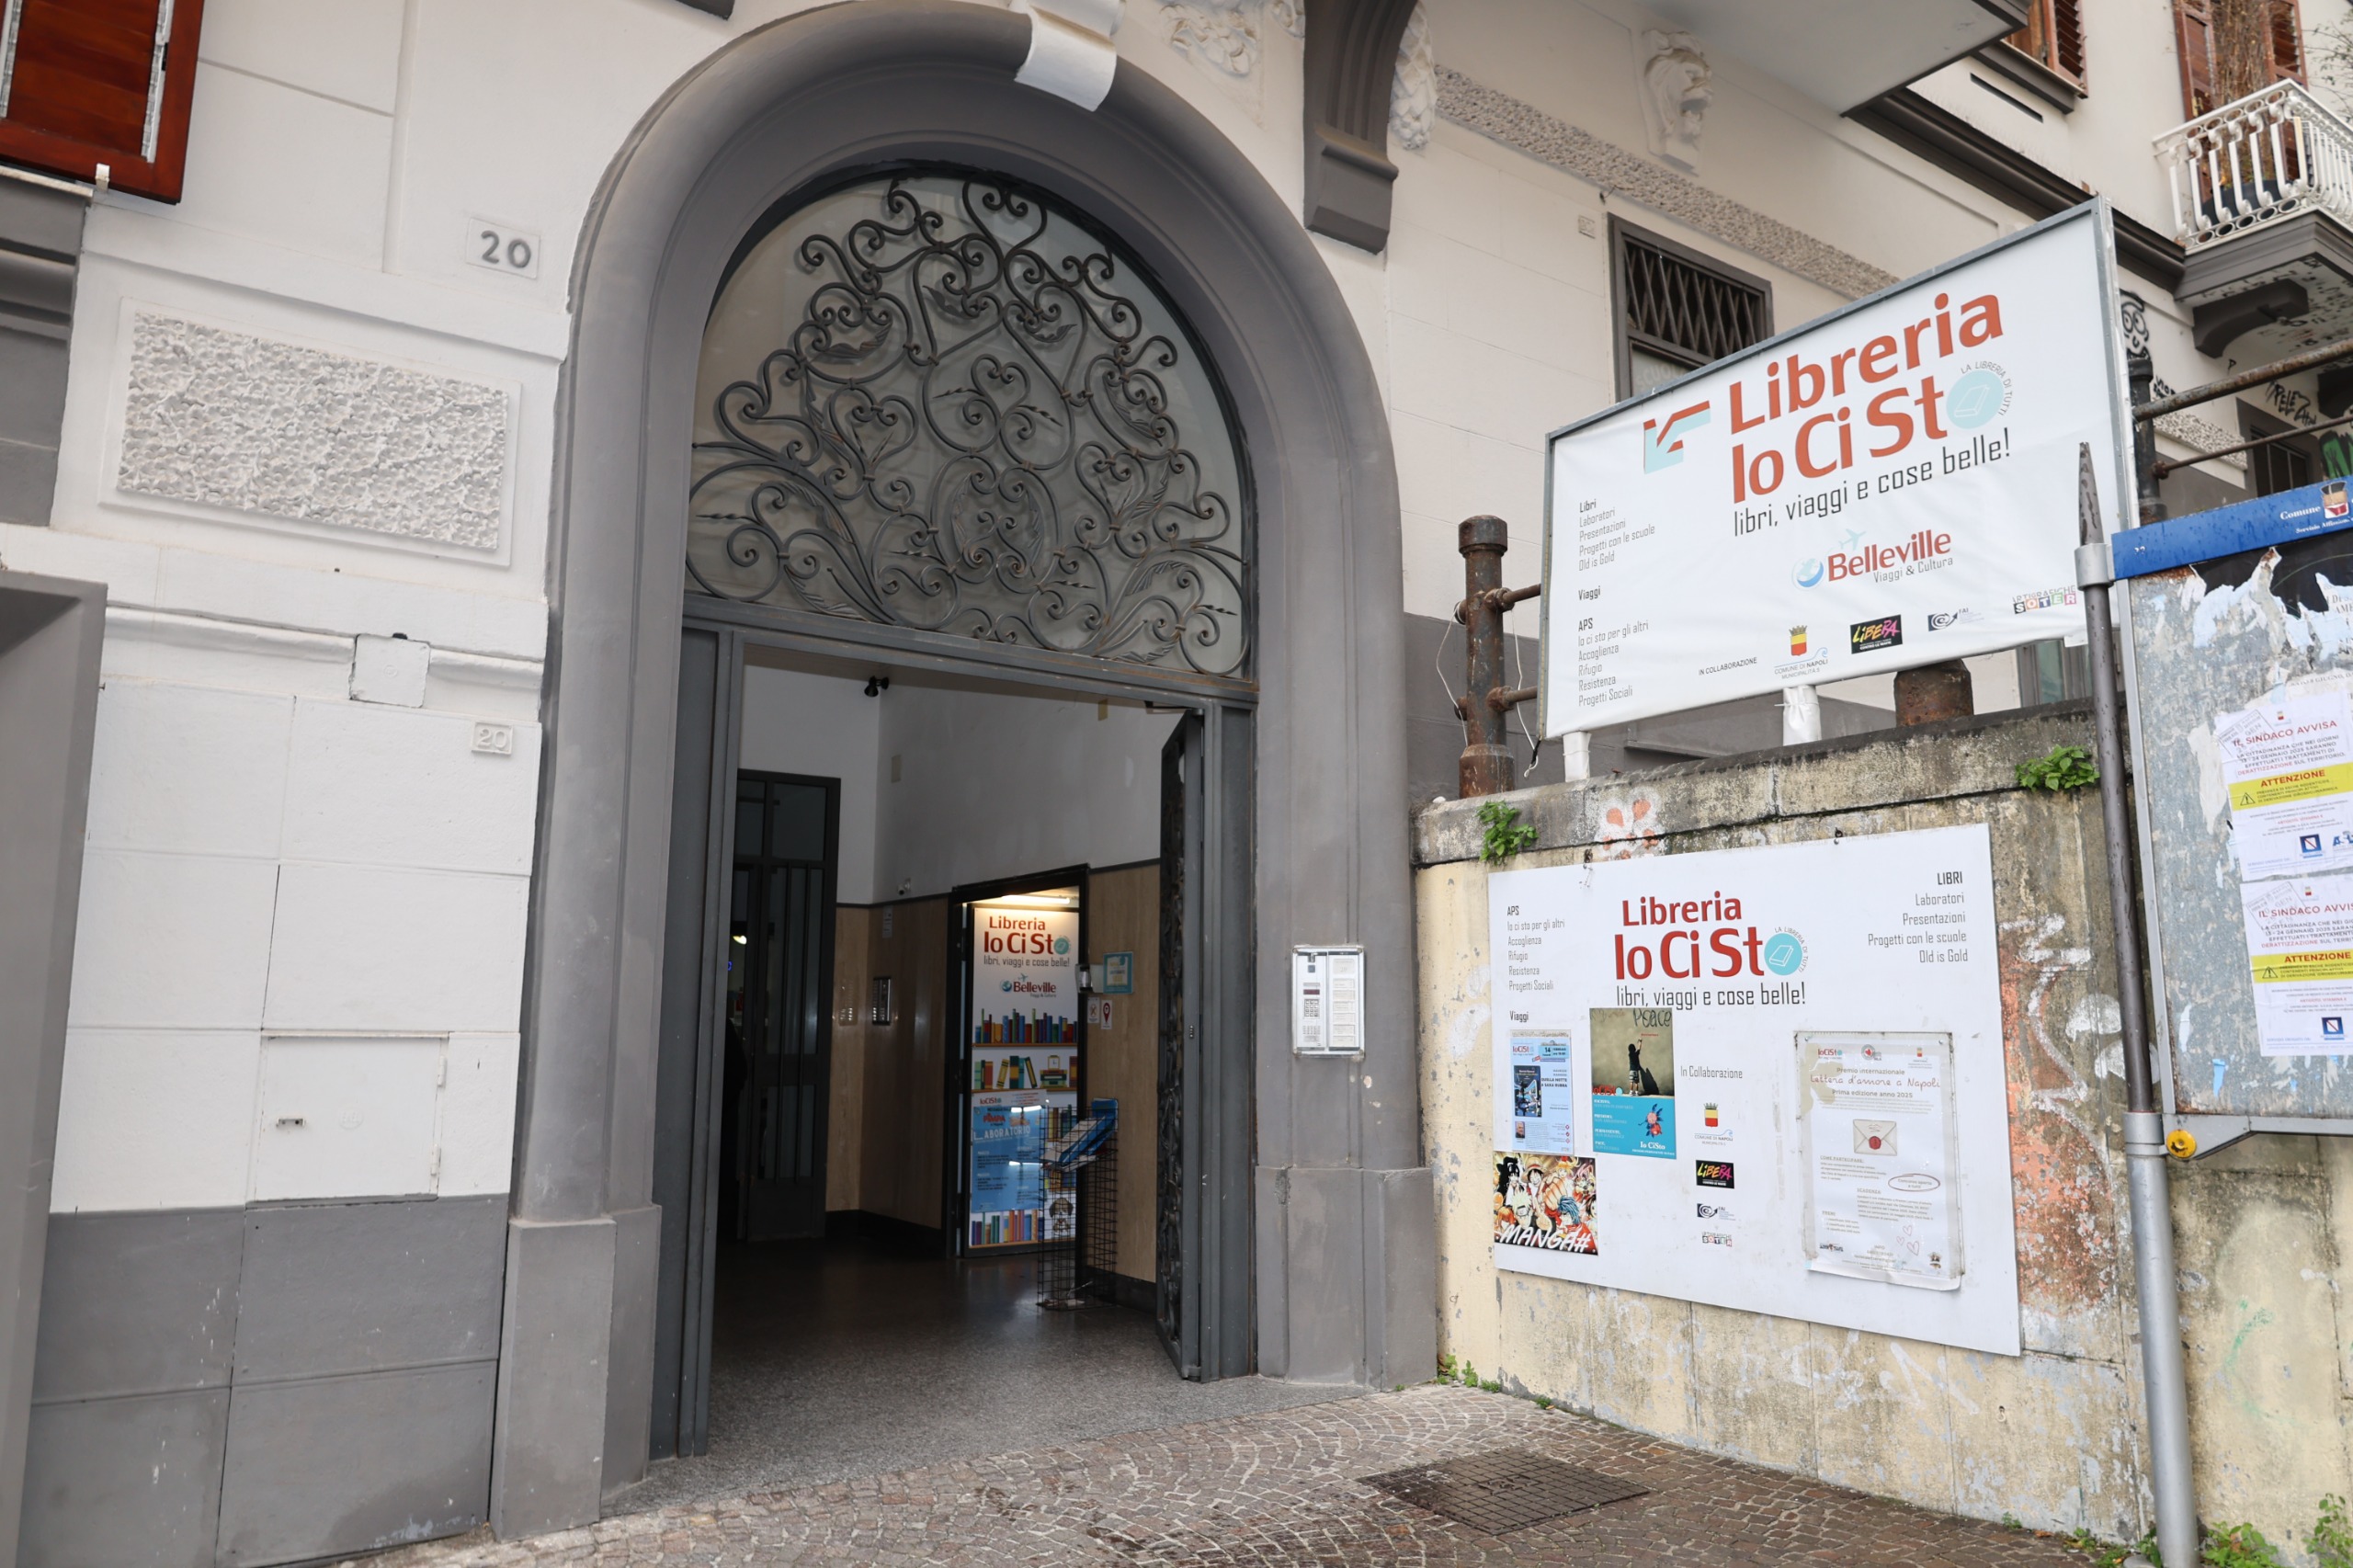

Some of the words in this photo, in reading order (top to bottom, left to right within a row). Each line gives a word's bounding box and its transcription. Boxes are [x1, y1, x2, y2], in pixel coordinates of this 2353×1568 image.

[481, 230, 531, 268] 20
[1730, 292, 2004, 435] Libreria
[1961, 364, 1972, 374] LA
[1975, 360, 2006, 379] LIBRERIA
[2003, 378, 2012, 389] DI
[1997, 391, 2013, 416] TUTTI
[1795, 406, 1853, 479] Ci
[1734, 504, 1779, 537] libri,
[1786, 481, 1847, 520] viaggi
[1858, 481, 1869, 500] e
[1879, 461, 1932, 494] cose
[1942, 427, 2010, 474] belle!
[1579, 498, 1597, 513] Libri
[2279, 506, 2322, 520] Comune
[1579, 506, 1615, 528] Laboratori
[1579, 517, 1626, 542] Presentazioni
[1579, 540, 1607, 557] Progetti
[1608, 536, 1621, 548] con
[1622, 531, 1630, 543] le
[1631, 524, 1655, 540] scuole
[1578, 558, 1590, 571] Old
[1591, 557, 1597, 568] is
[1599, 550, 1615, 565] Gold
[1828, 529, 1951, 582] Belleville
[1873, 567, 1904, 583] Viaggi
[1905, 565, 1915, 575] &
[1918, 556, 1953, 574] Cultura
[1578, 585, 1600, 600] Viaggi
[2014, 593, 2076, 614] SOTER
[1578, 618, 1593, 632] APS
[1586, 634, 1593, 645] ci
[1595, 632, 1606, 643] sto
[1608, 629, 1620, 642] per
[1622, 623, 1631, 639] gli
[1632, 619, 1649, 633] altri
[1578, 644, 1620, 662] Accoglienza
[1578, 663, 1602, 677] Rifugio
[1705, 656, 1757, 675] COLLABORAZIONE
[1774, 665, 1798, 675] COMUNE
[1806, 659, 1828, 668] NAPOLI
[1578, 676, 1617, 692] Resistenza
[1578, 691, 1608, 707] Progetti
[1608, 685, 1633, 701] Sociali
[478, 729, 507, 750] 20
[2245, 729, 2293, 745] SINDACO
[2297, 720, 2337, 734] AVVISA
[2245, 743, 2290, 757] CITTADINANZA
[2245, 756, 2280, 768] EFFETTUATI
[2285, 748, 2326, 761] TRATTAMENTI
[2261, 749, 2288, 761] GENNAIO
[2305, 742, 2336, 752] SARANNO
[2237, 761, 2293, 776] DERATTIZZAZIONE
[2260, 769, 2325, 788] ATTENZIONE
[1938, 871, 1963, 885] LIBRI
[1915, 892, 1964, 906] Laboratori
[1507, 905, 1519, 916] APS
[1622, 891, 1742, 926] Libreria
[2271, 906, 2320, 917] SINDACO
[989, 916, 1046, 931] Libreria
[1514, 920, 1519, 931] ci
[1521, 922, 1530, 930] sto
[1531, 922, 1542, 931] per
[1552, 918, 1564, 928] altri
[1903, 912, 1966, 926] Presentazioni
[1007, 932, 1026, 954] Ci
[1507, 936, 1542, 948] Accoglienza
[1868, 933, 1904, 948] Progetti
[1906, 934, 1923, 945] con
[1926, 931, 1934, 944] le
[1937, 929, 1967, 943] scuole
[2261, 940, 2318, 949] DERATTIZZAZIONE
[983, 955, 1000, 966] libri,
[1003, 956, 1024, 969] viaggi
[1026, 958, 1030, 966] e
[1032, 958, 1049, 966] cose
[1051, 957, 1070, 967] belle!
[1508, 950, 1529, 962] Rifugio
[1660, 930, 1700, 979] Ci
[1919, 949, 1934, 963] Old
[1937, 951, 1945, 962] is
[1948, 949, 1968, 962] Gold
[2284, 951, 2351, 963] ATTENZIONE
[1508, 966, 1540, 976] Resistenza
[1013, 981, 1056, 993] Belleville
[1509, 980, 1533, 993] Progetti
[1533, 980, 1553, 991] Sociali
[1616, 985, 1648, 1007] libri,
[1654, 987, 1697, 1011] viaggi
[1703, 992, 1711, 1006] e
[1717, 991, 1755, 1006] cose
[1761, 982, 1805, 1005] belle!
[1509, 1011, 1529, 1023] Viaggi
[1633, 1008, 1672, 1028] Peace
[1680, 1065, 1688, 1078] In
[1688, 1065, 1743, 1079] Collaborazione
[1810, 1074, 1844, 1084] Lettera
[1848, 1075, 1891, 1086] d'amore
[1907, 1077, 1940, 1091] Napoli
